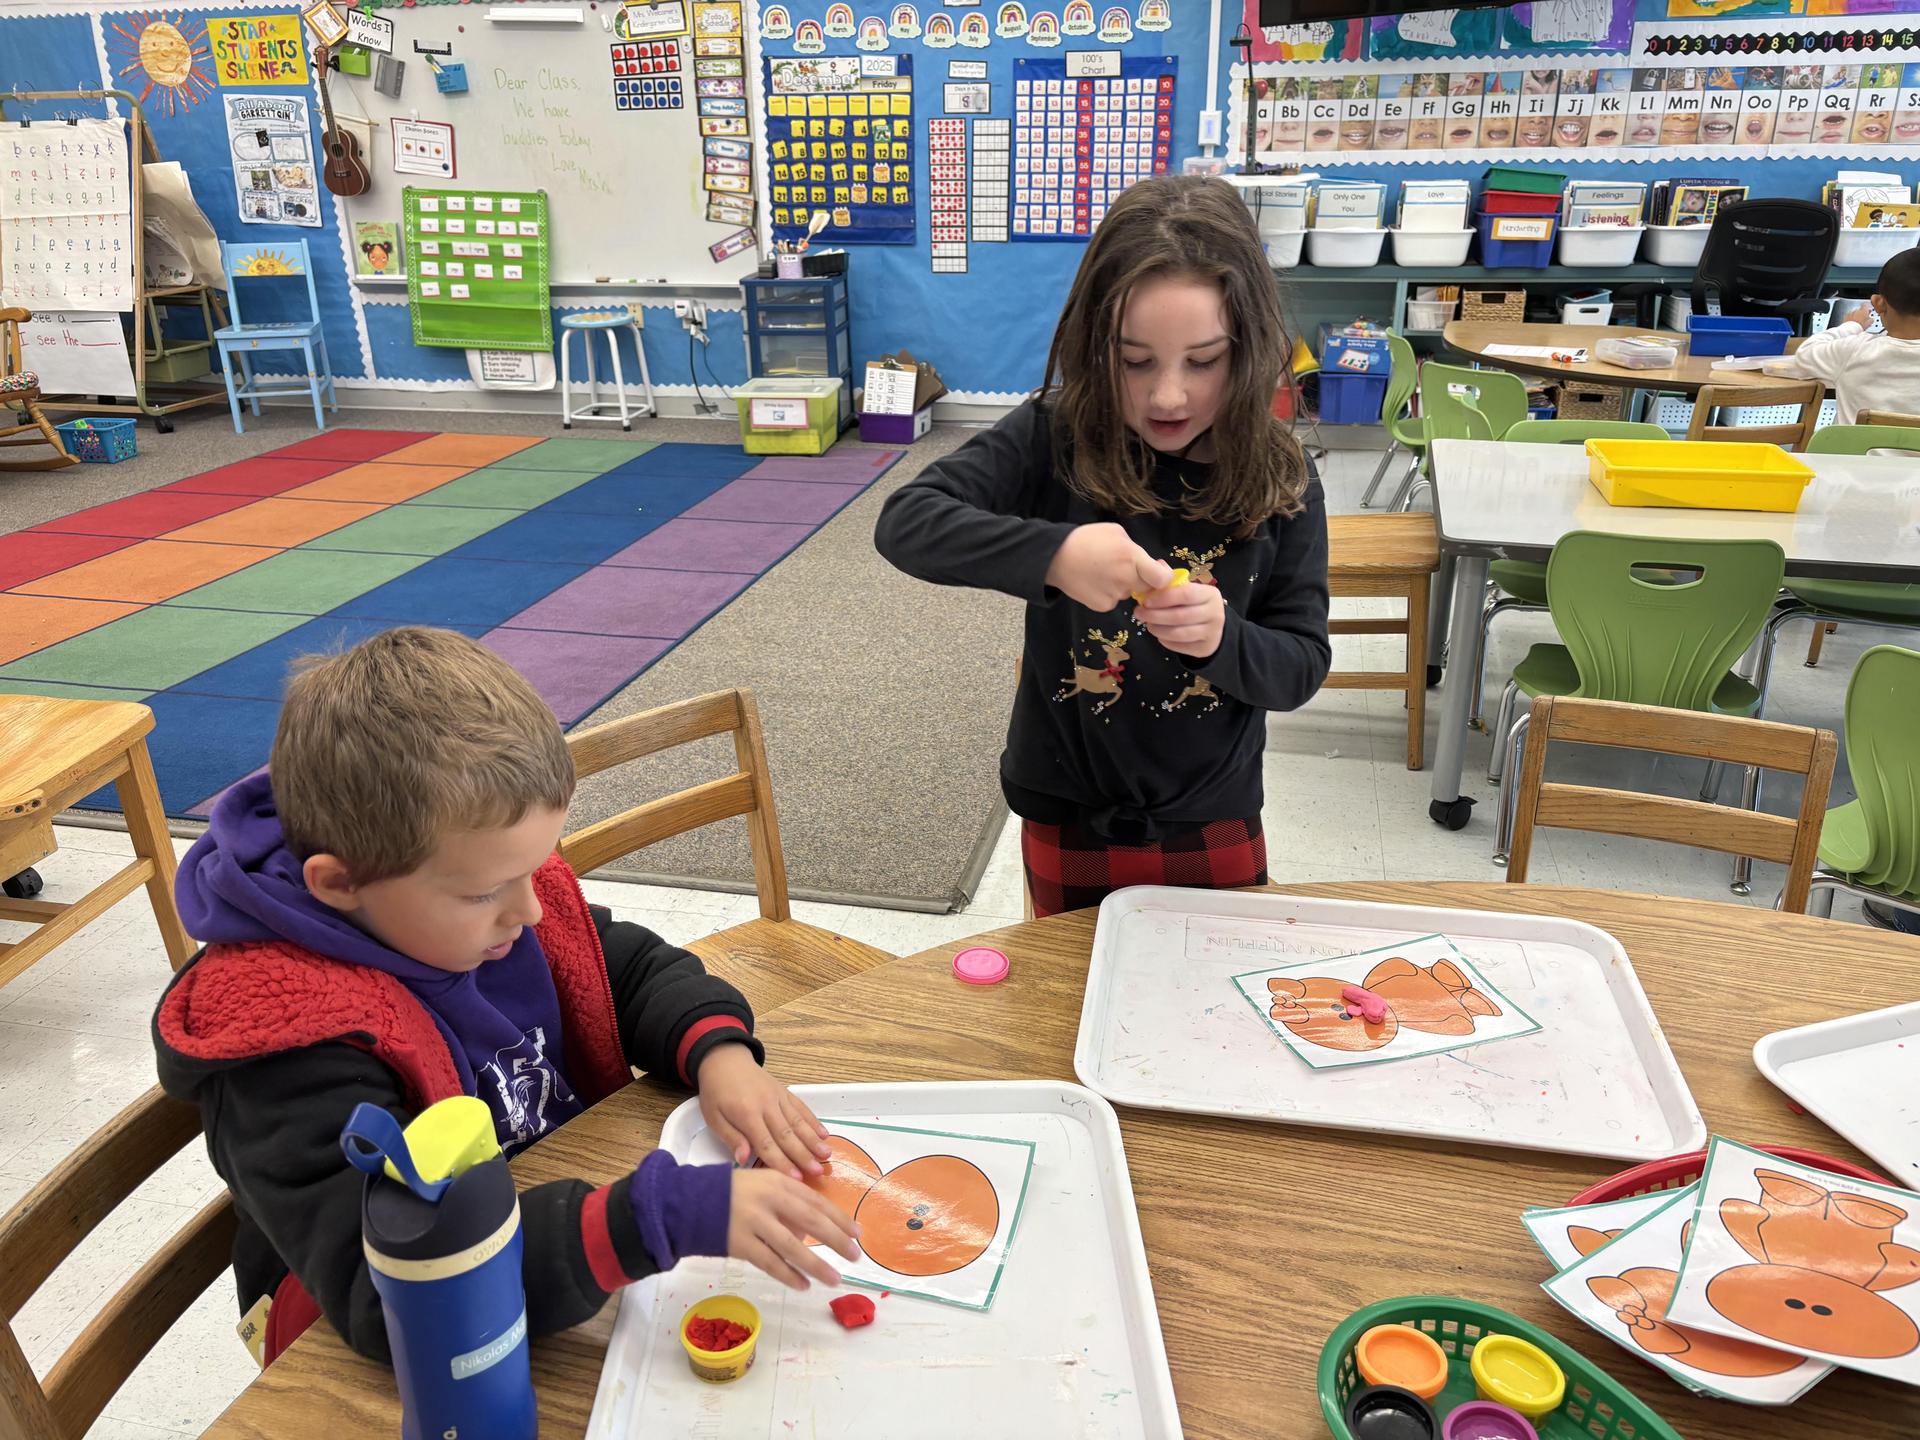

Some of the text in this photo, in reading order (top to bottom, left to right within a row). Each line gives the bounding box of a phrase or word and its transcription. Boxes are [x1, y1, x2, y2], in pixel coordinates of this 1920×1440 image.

[352, 15, 381, 31] Words
[385, 24, 390, 33] I
[228, 21, 268, 40] STAR
[357, 32, 381, 46] Know
[867, 39, 879, 47] April
[1650, 34, 1914, 50] 0 1 2 3 4 5 6 7 8 9 10 11 12 13 14 15
[217, 40, 297, 60] STUDENTS
[226, 61, 280, 80] SHINE
[866, 60, 893, 72] 2025
[1081, 66, 1105, 75] Chart
[494, 68, 528, 89] Dear
[782, 68, 858, 86] December
[872, 80, 897, 89] Friday
[257, 100, 294, 112] About
[513, 97, 571, 118] We have
[1282, 106, 1299, 118] Bb
[1314, 105, 1335, 118] Cc
[1350, 104, 1369, 117] Dd
[1385, 104, 1402, 116] Ee
[1423, 102, 1435, 115] Ff
[1452, 101, 1475, 117] Gg
[1491, 101, 1510, 114] Hh
[1529, 99, 1544, 112] Ii
[1568, 99, 1583, 115] Jj
[1601, 98, 1620, 111] Kk
[1641, 97, 1654, 110] Ll
[1668, 97, 1698, 110] Mm
[1711, 96, 1732, 109] Nn
[1748, 95, 1772, 109] Oo
[1788, 95, 1808, 111] Pp
[1825, 95, 1850, 110] Qq
[1869, 94, 1885, 107] Rr
[241, 109, 275, 119] GARRETT
[800, 148, 805, 156] 8
[819, 148, 824, 156] 9
[835, 148, 844, 156] 10
[857, 148, 865, 156] 11
[878, 149, 887, 157] 12
[796, 169, 805, 177] 15
[814, 171, 823, 179] 16
[836, 170, 845, 178] 17
[857, 171, 866, 179] 18
[896, 172, 908, 180] 20
[777, 192, 906, 201] 21 22 23 24 26 27
[1275, 190, 1297, 198] Stories
[1333, 193, 1350, 201] Only
[1592, 191, 1624, 199] Feelings
[778, 214, 806, 223] 28 29
[1582, 212, 1629, 226] Listening
[1502, 224, 1540, 233] Handwriting
[58, 314, 66, 323] a
[18, 332, 29, 346] I
[62, 329, 79, 346] the
[460, 1340, 512, 1371] Nikolas
